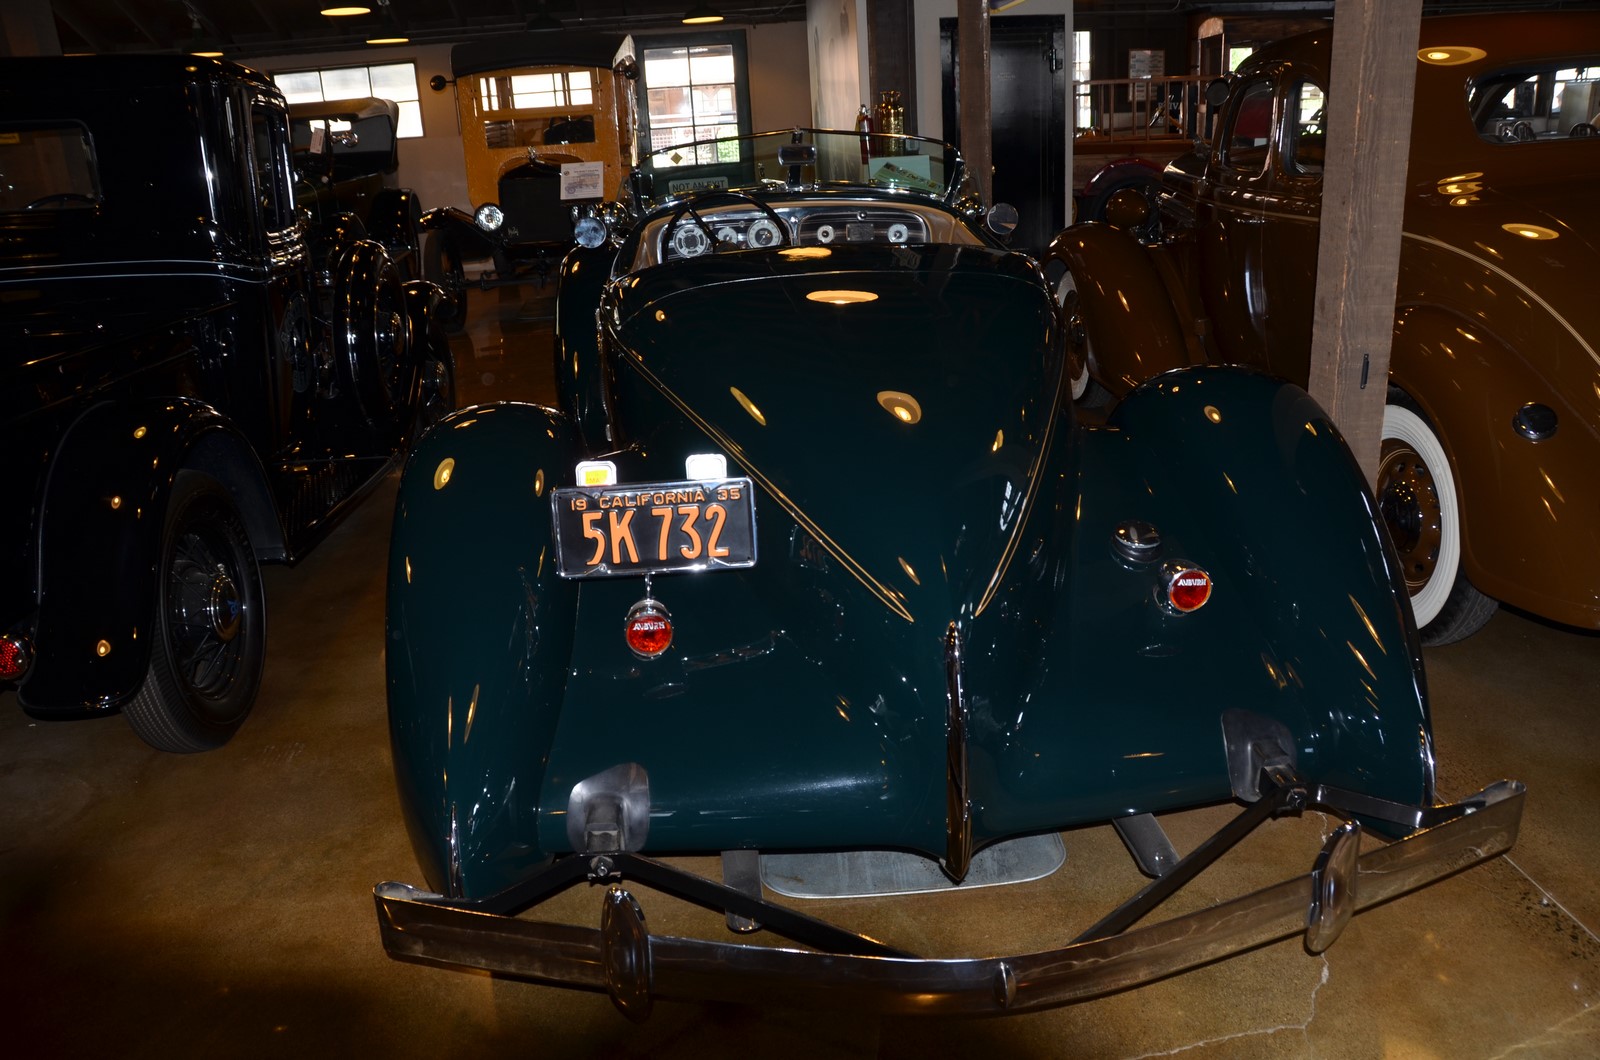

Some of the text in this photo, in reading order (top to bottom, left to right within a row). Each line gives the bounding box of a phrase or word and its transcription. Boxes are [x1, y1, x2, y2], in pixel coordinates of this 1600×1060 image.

[672, 179, 725, 192] NOT AN EXIT
[571, 487, 741, 511] 19 CALIFORNIA 35
[581, 504, 731, 565] 5K 732
[1177, 578, 1207, 586] AUBURN
[633, 621, 666, 631] AUBURN
